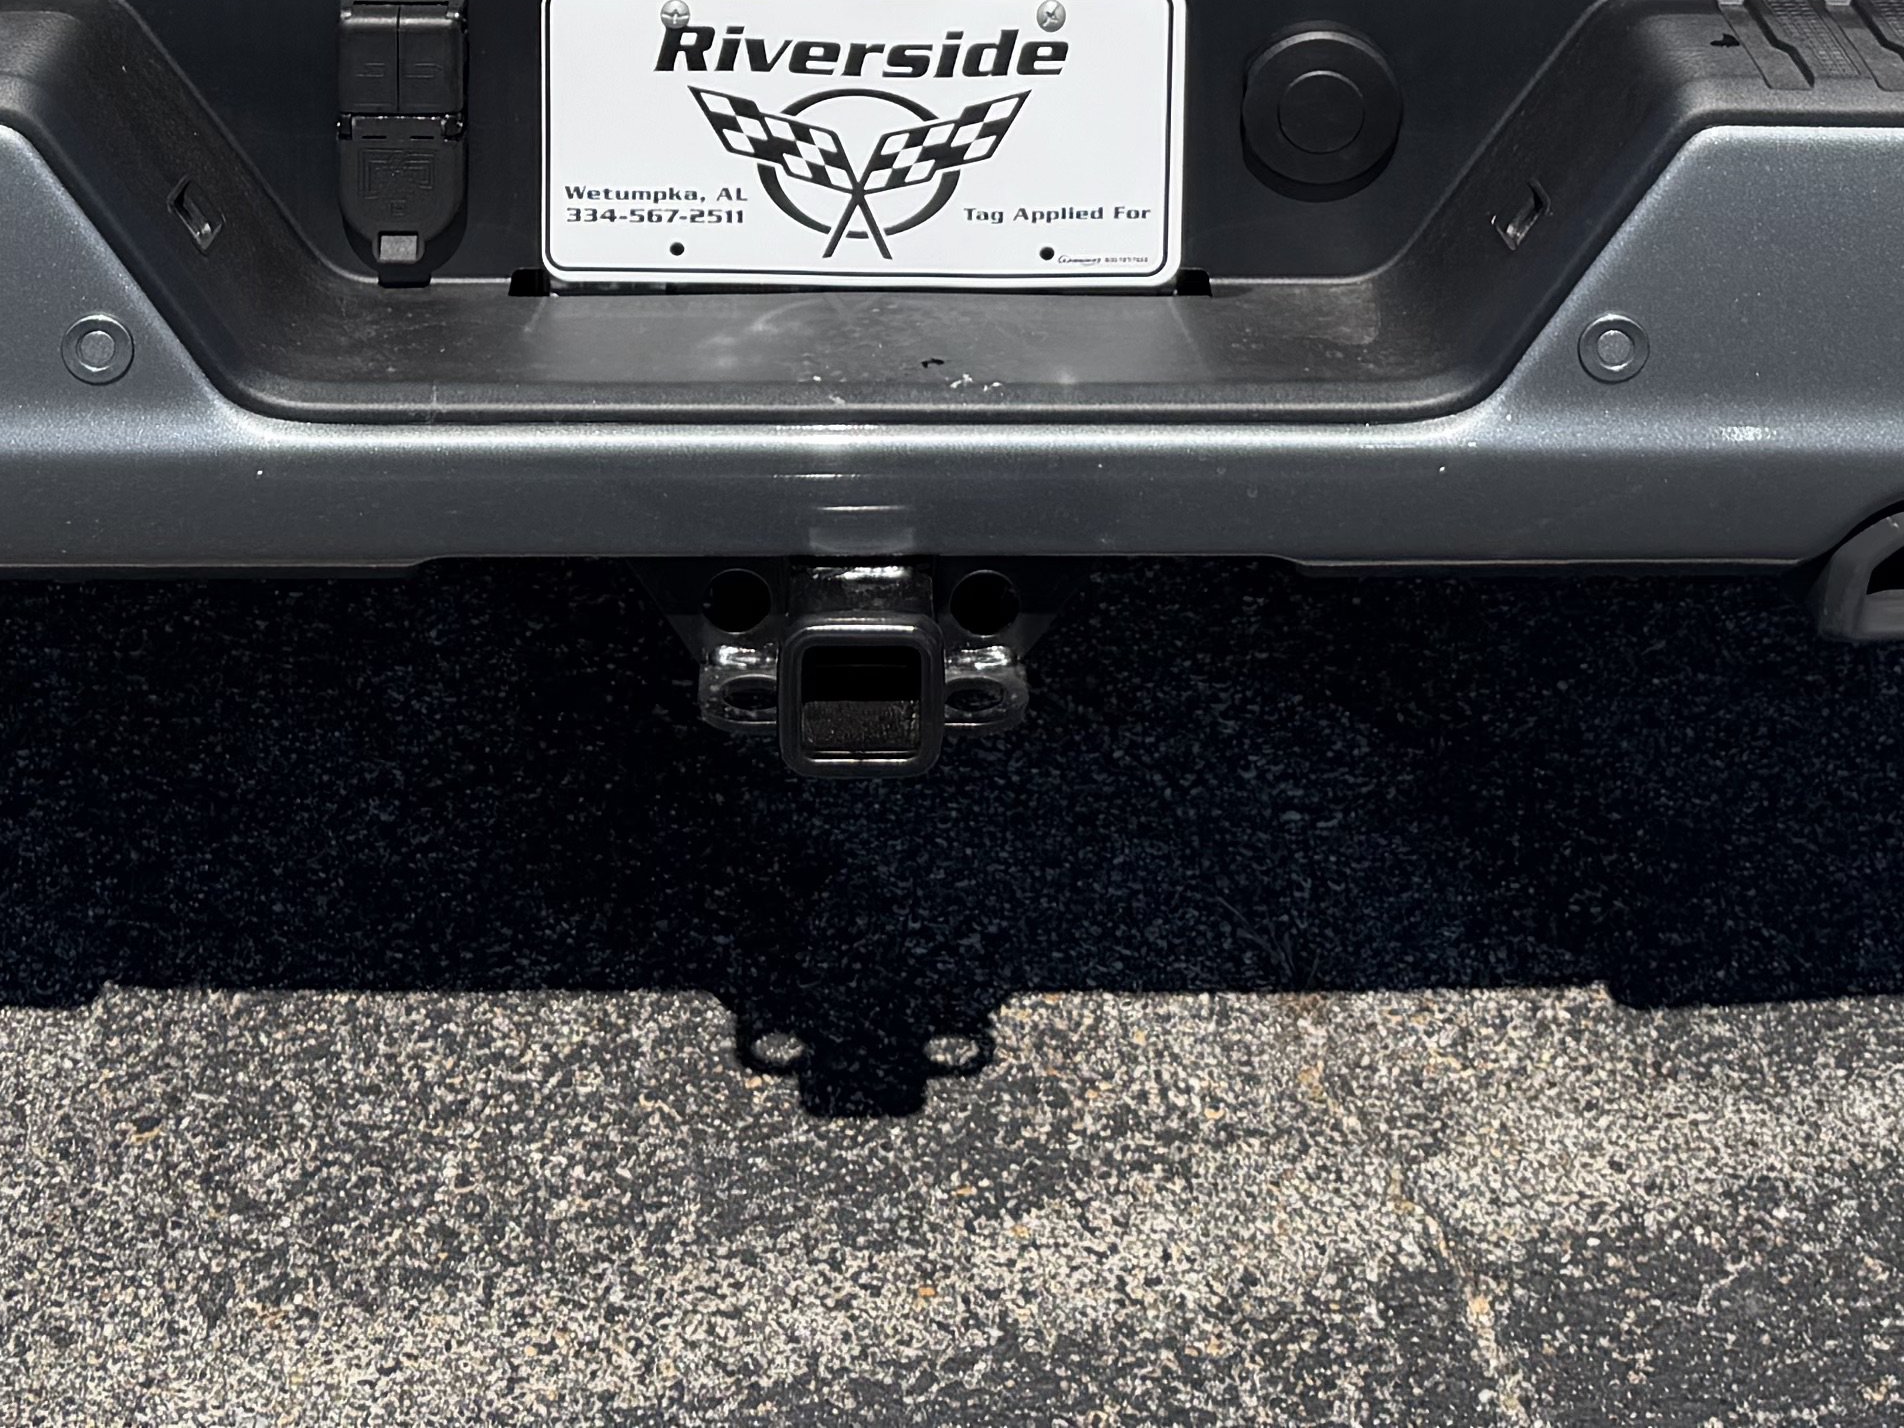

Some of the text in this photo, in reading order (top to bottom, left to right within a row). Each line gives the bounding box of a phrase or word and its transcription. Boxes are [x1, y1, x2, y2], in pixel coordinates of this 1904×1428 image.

[653, 24, 1070, 79] Riverside
[564, 185, 748, 204] Wetumpka, AL
[566, 207, 744, 224] 334-567-2511
[963, 205, 1152, 225] Tag Applied For
